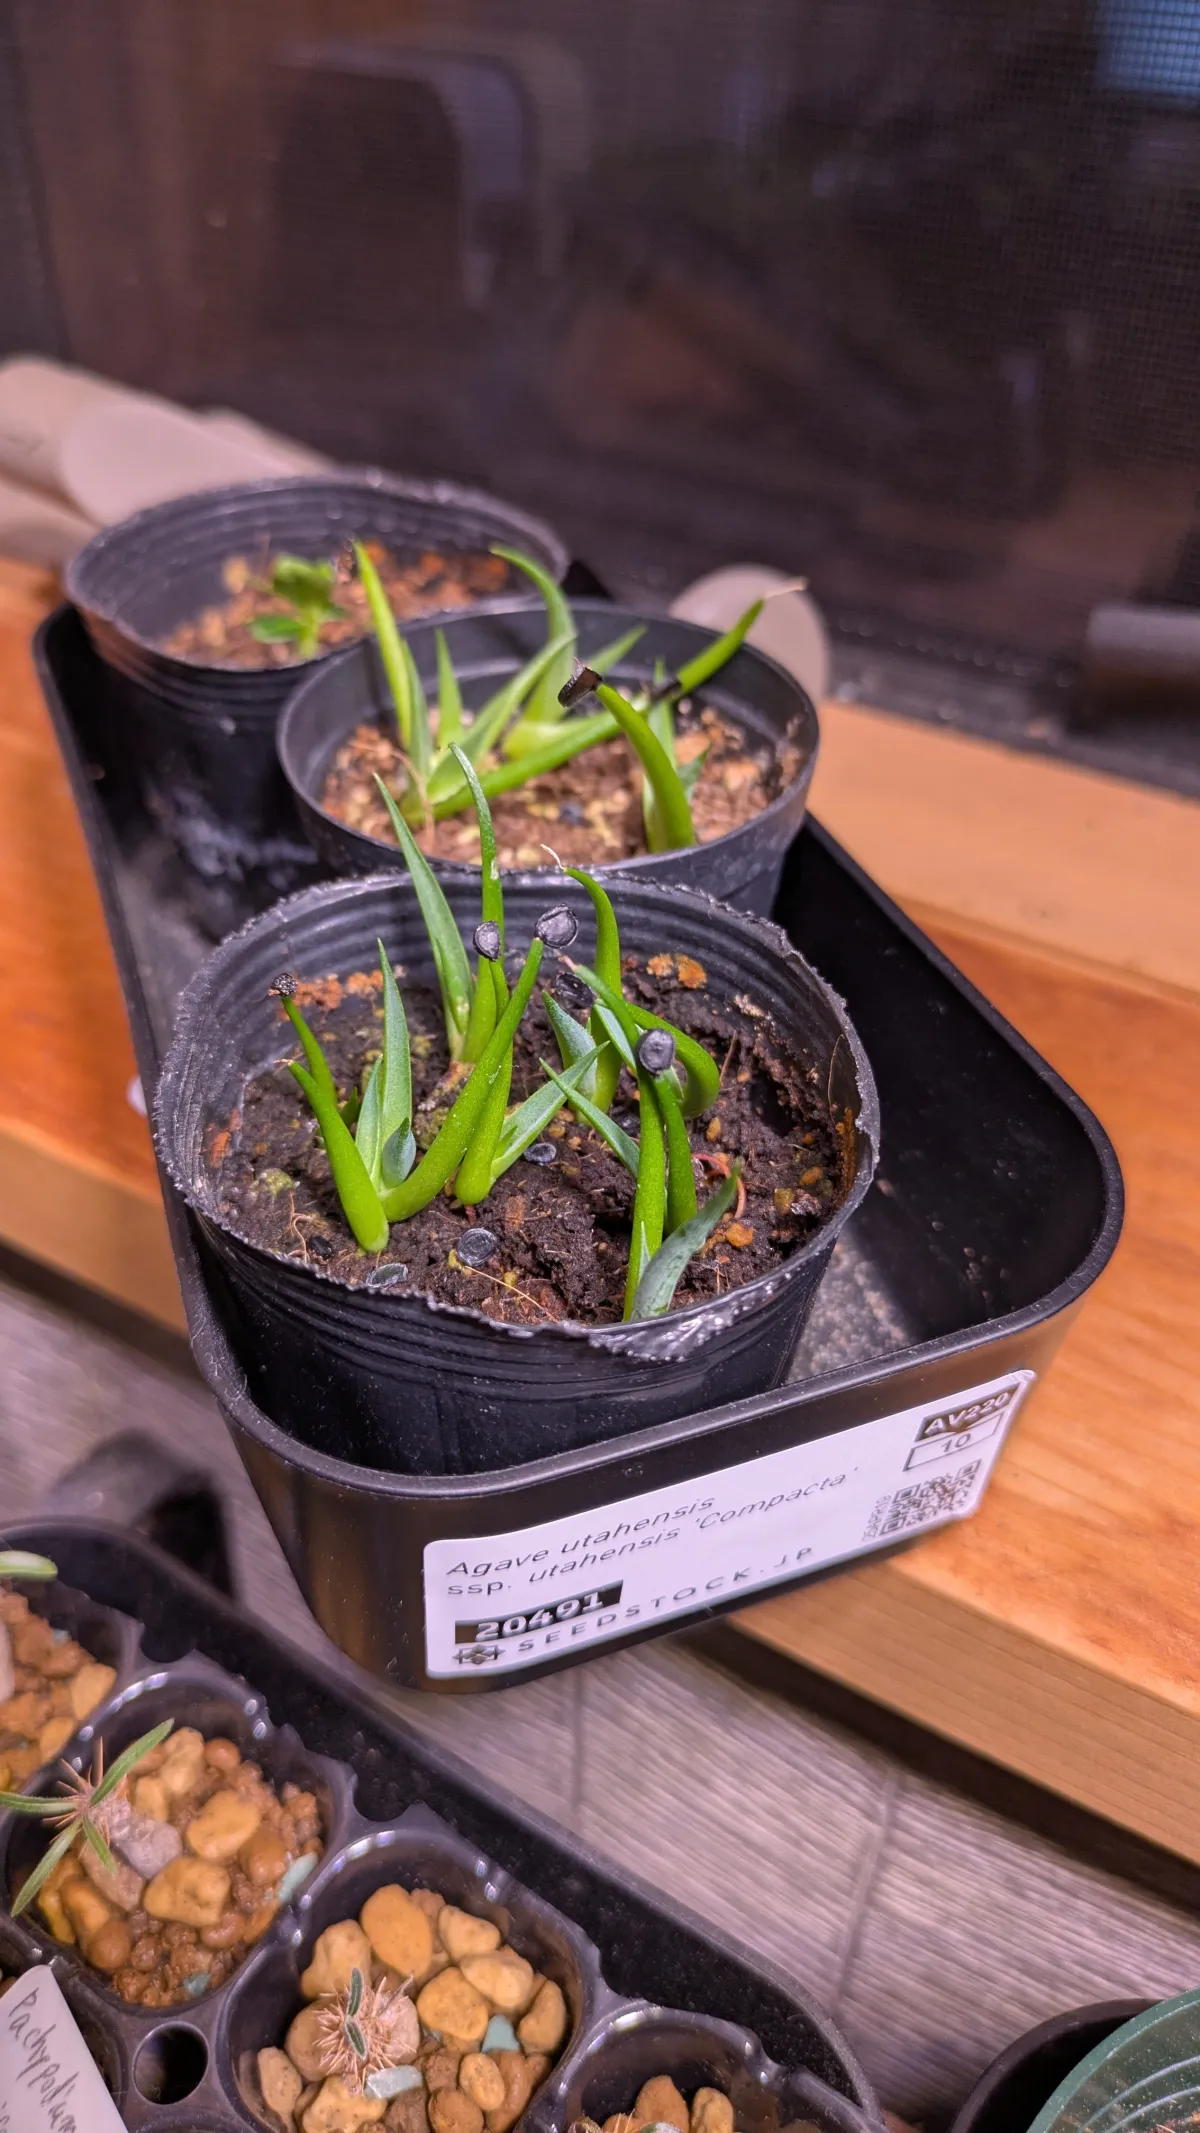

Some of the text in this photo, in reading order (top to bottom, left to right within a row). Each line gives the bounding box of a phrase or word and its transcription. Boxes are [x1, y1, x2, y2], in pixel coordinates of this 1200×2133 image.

[924, 1391, 1011, 1437] AV220
[940, 1432, 972, 1453] 10
[446, 1496, 716, 1578] Agave utahensis
[447, 1466, 859, 1596] ssp. utahensis 'Compacta'
[474, 1591, 604, 1643] 20491
[517, 1546, 812, 1652] SEEDSTOCK.JP
